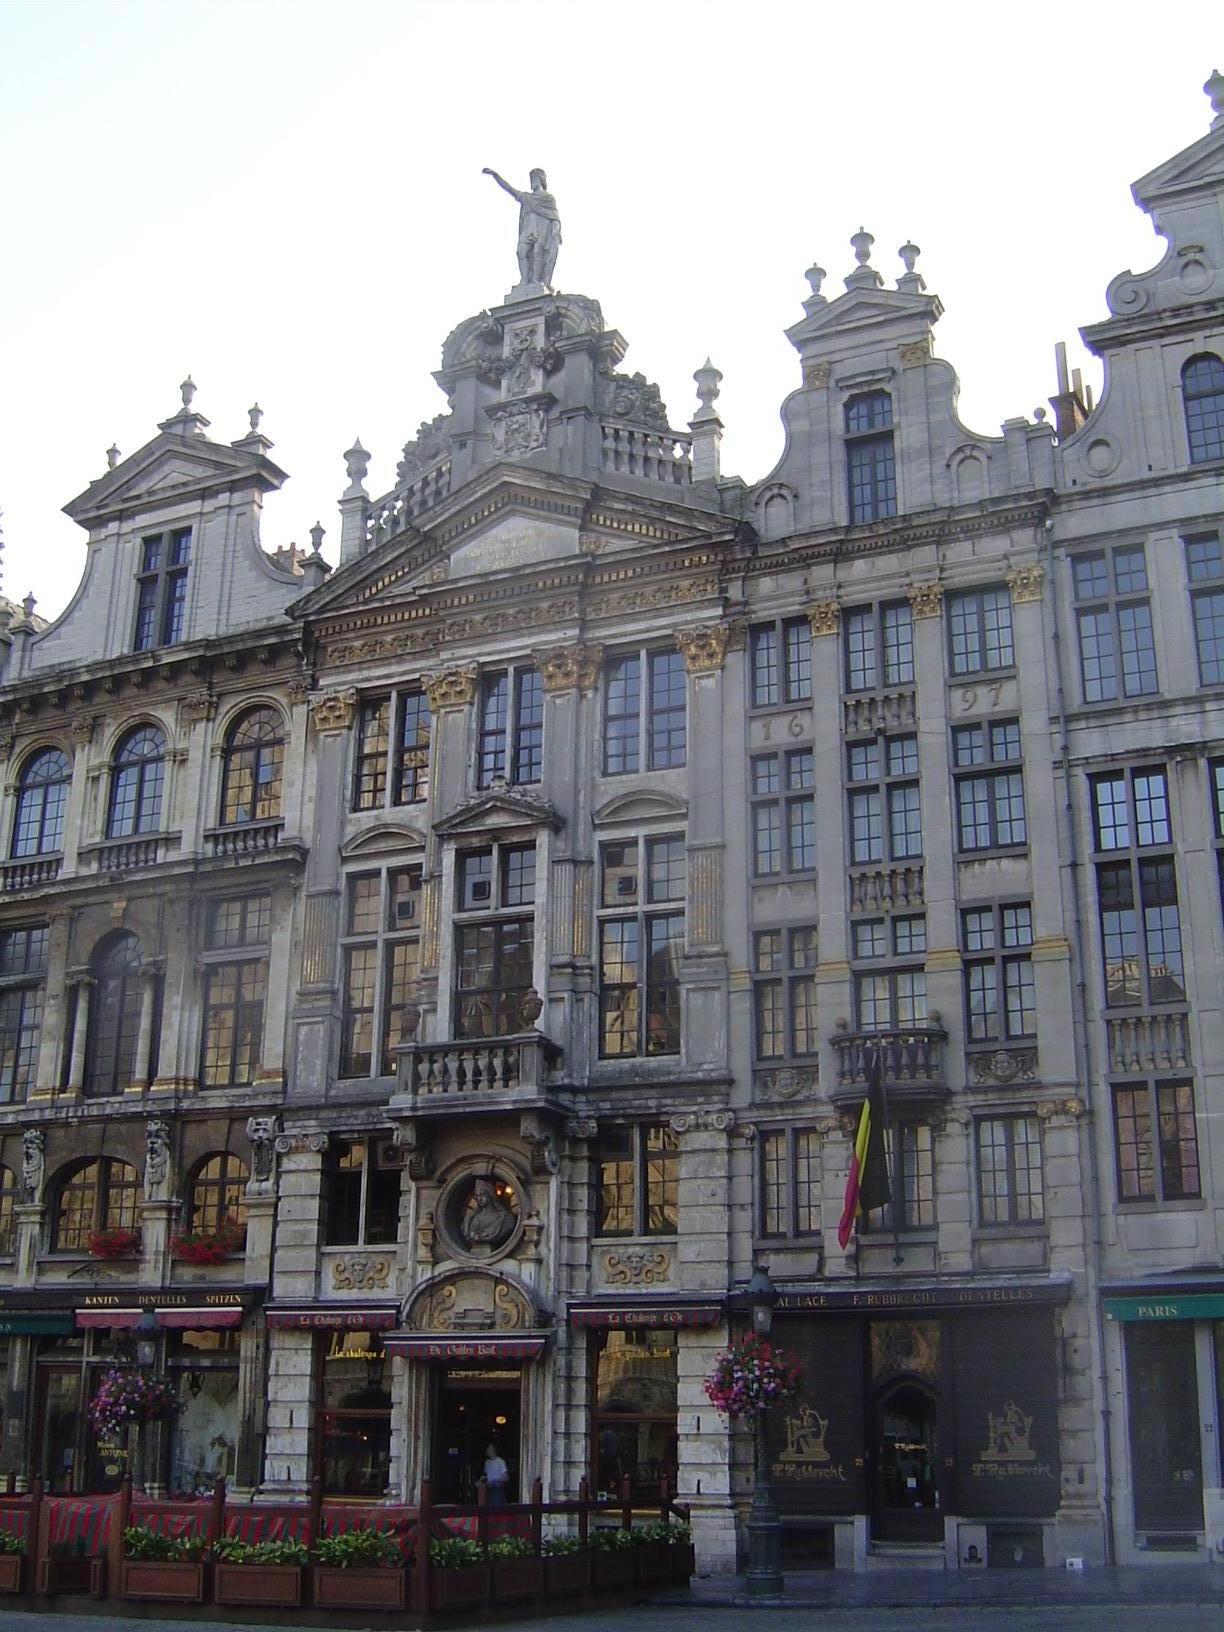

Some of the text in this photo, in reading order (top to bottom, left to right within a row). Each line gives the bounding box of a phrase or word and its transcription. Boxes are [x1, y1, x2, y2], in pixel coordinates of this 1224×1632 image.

[761, 714, 804, 742] 16
[85, 1294, 242, 1305] KANTEN DENTELLES SPITZEN
[797, 1295, 828, 1307] LACE
[959, 1289, 1033, 1302] DENTELLES
[1138, 1304, 1178, 1317] PARIS
